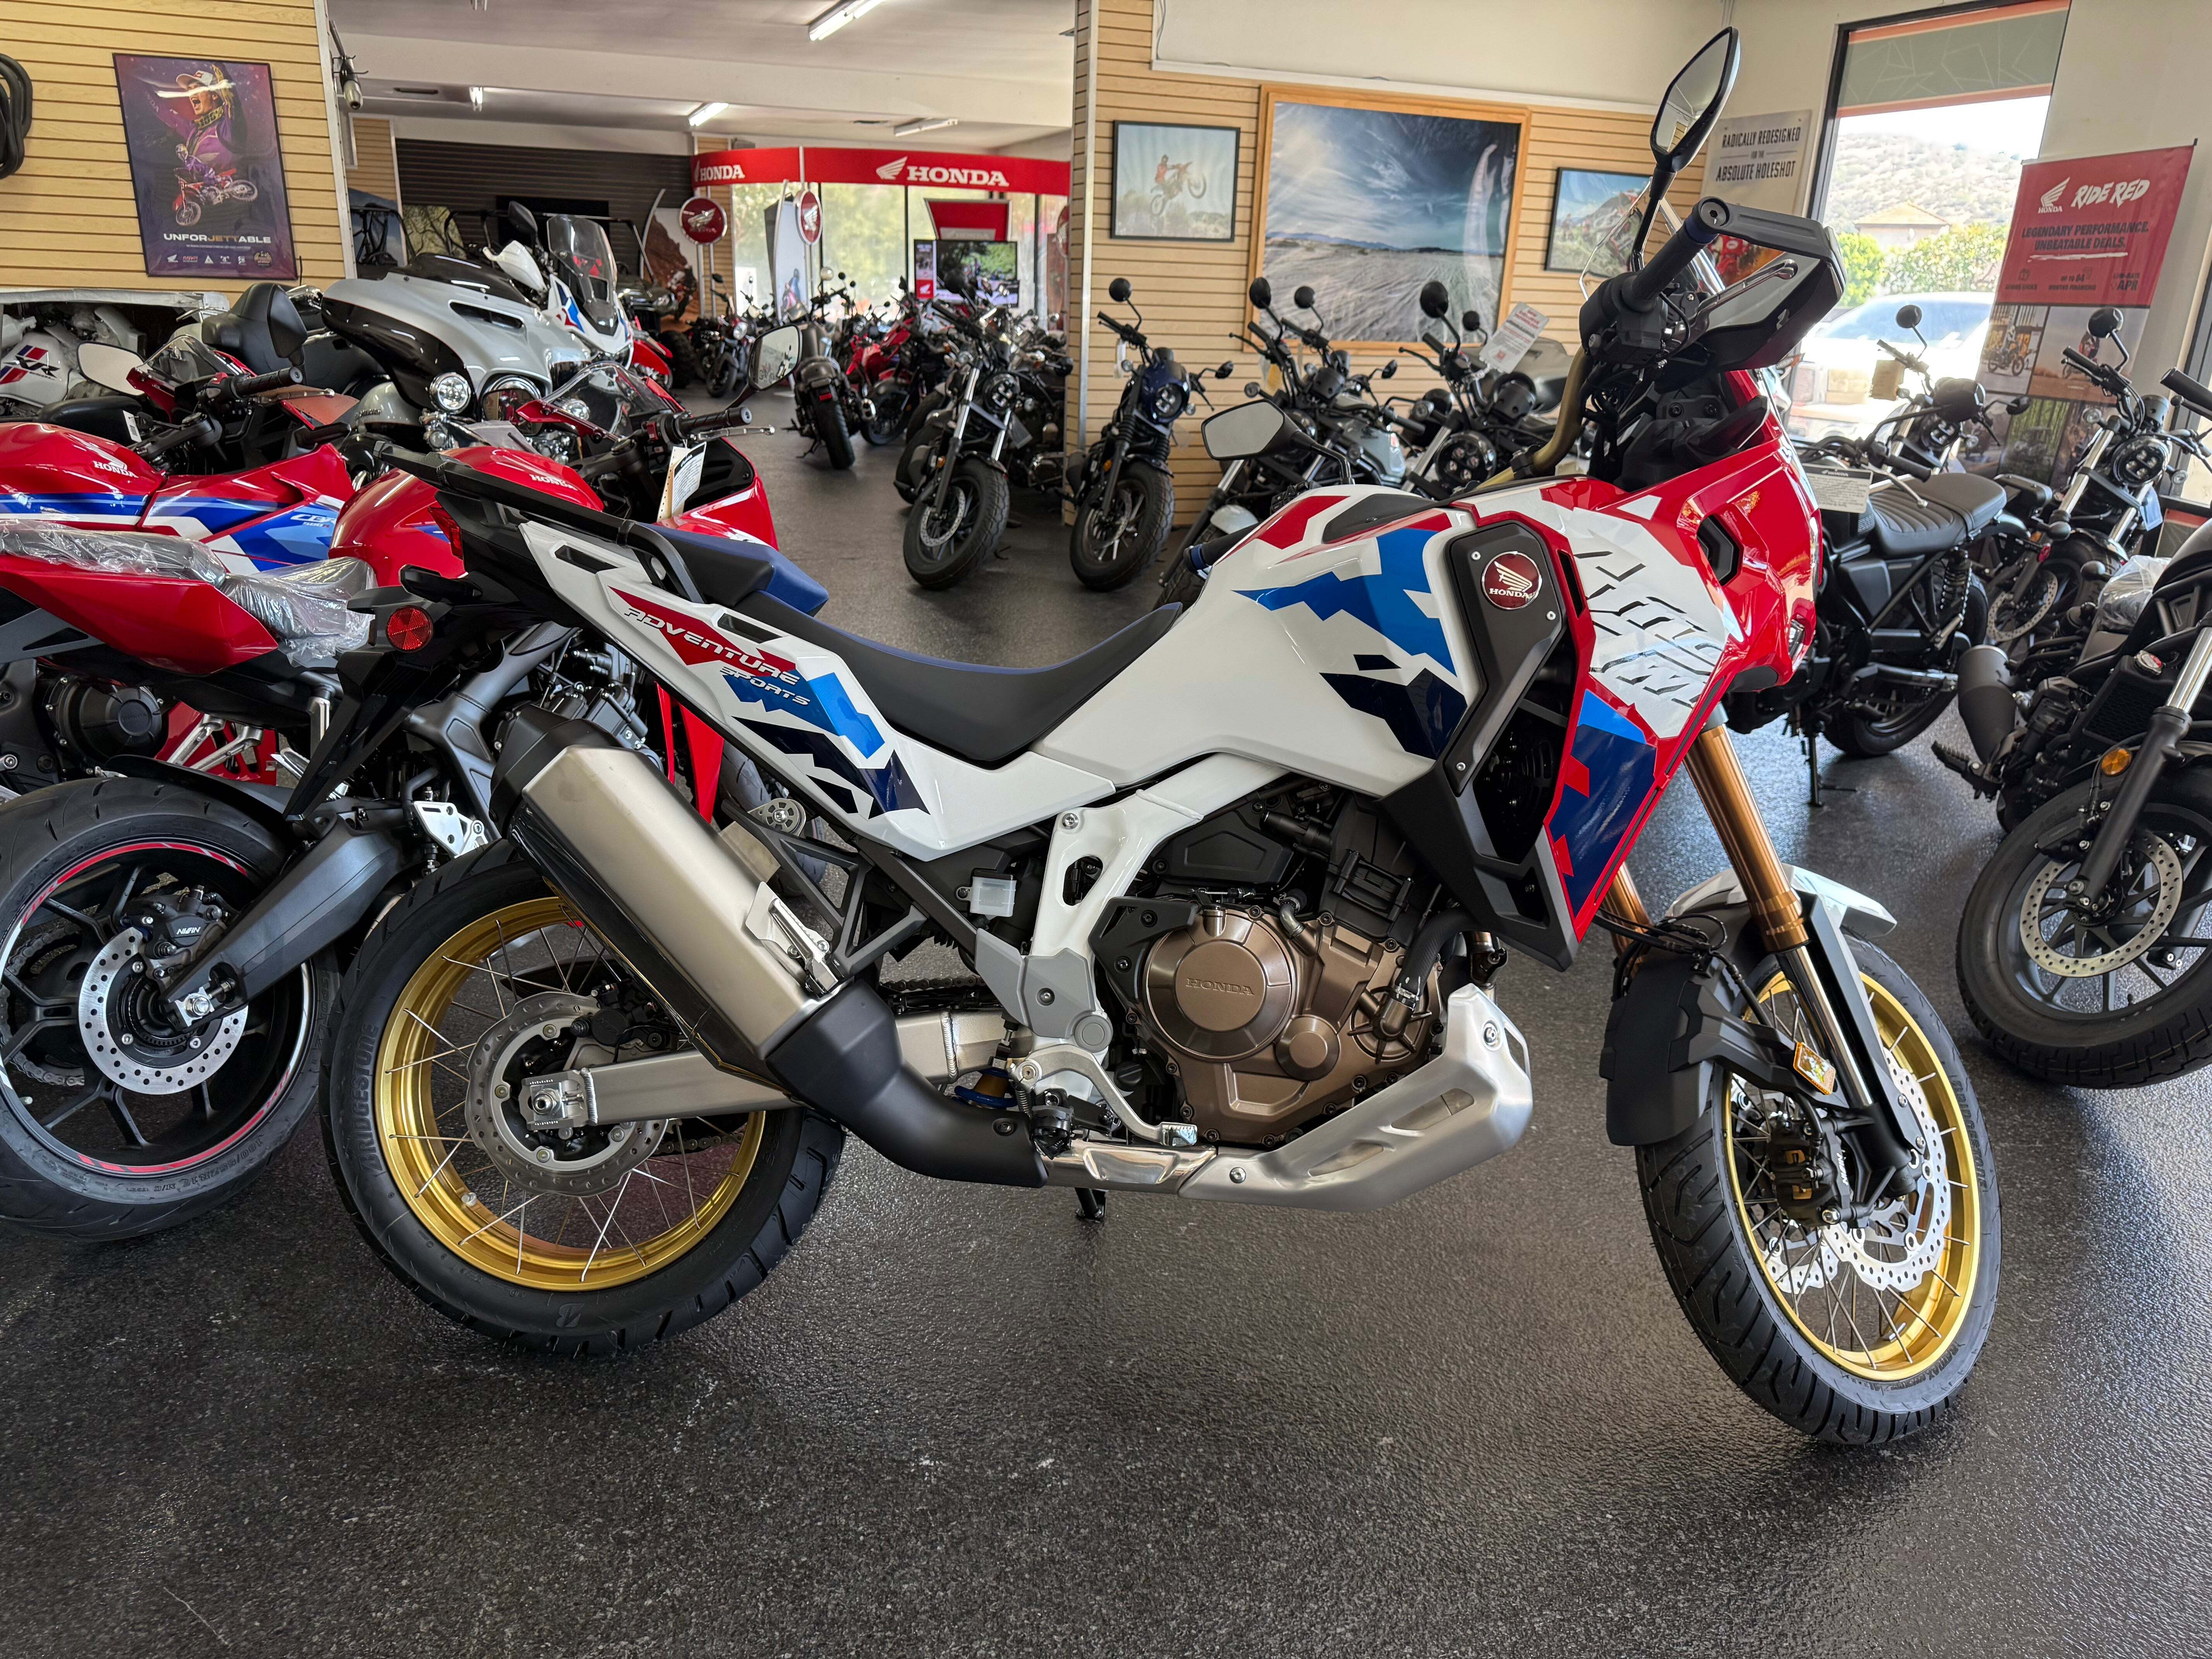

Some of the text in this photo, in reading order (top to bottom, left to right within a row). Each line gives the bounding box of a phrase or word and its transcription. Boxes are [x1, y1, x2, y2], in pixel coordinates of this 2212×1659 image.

[1722, 127, 1801, 148] RADICALLY REDESIGNED
[700, 165, 745, 181] HONDA
[907, 165, 1009, 187] HONDA
[1716, 161, 1796, 181] ABSOLUTE HOLESHOT
[2071, 178, 2150, 210] RIDE RED
[163, 233, 271, 243] UNFORJETTABLE
[2021, 221, 2149, 239] LEGENDARY PERFORMANCE.
[2034, 236, 2126, 251] UNBEATABLE DEALS.
[92, 460, 139, 479] HONDA
[529, 474, 578, 491] HONDA
[1489, 588, 1530, 599] HONDA
[624, 608, 800, 685] ADVENTURE
[719, 666, 811, 706] SPORTS
[1185, 978, 1255, 996] HONDA
[350, 1023, 383, 1173] BRIDGESTONE
